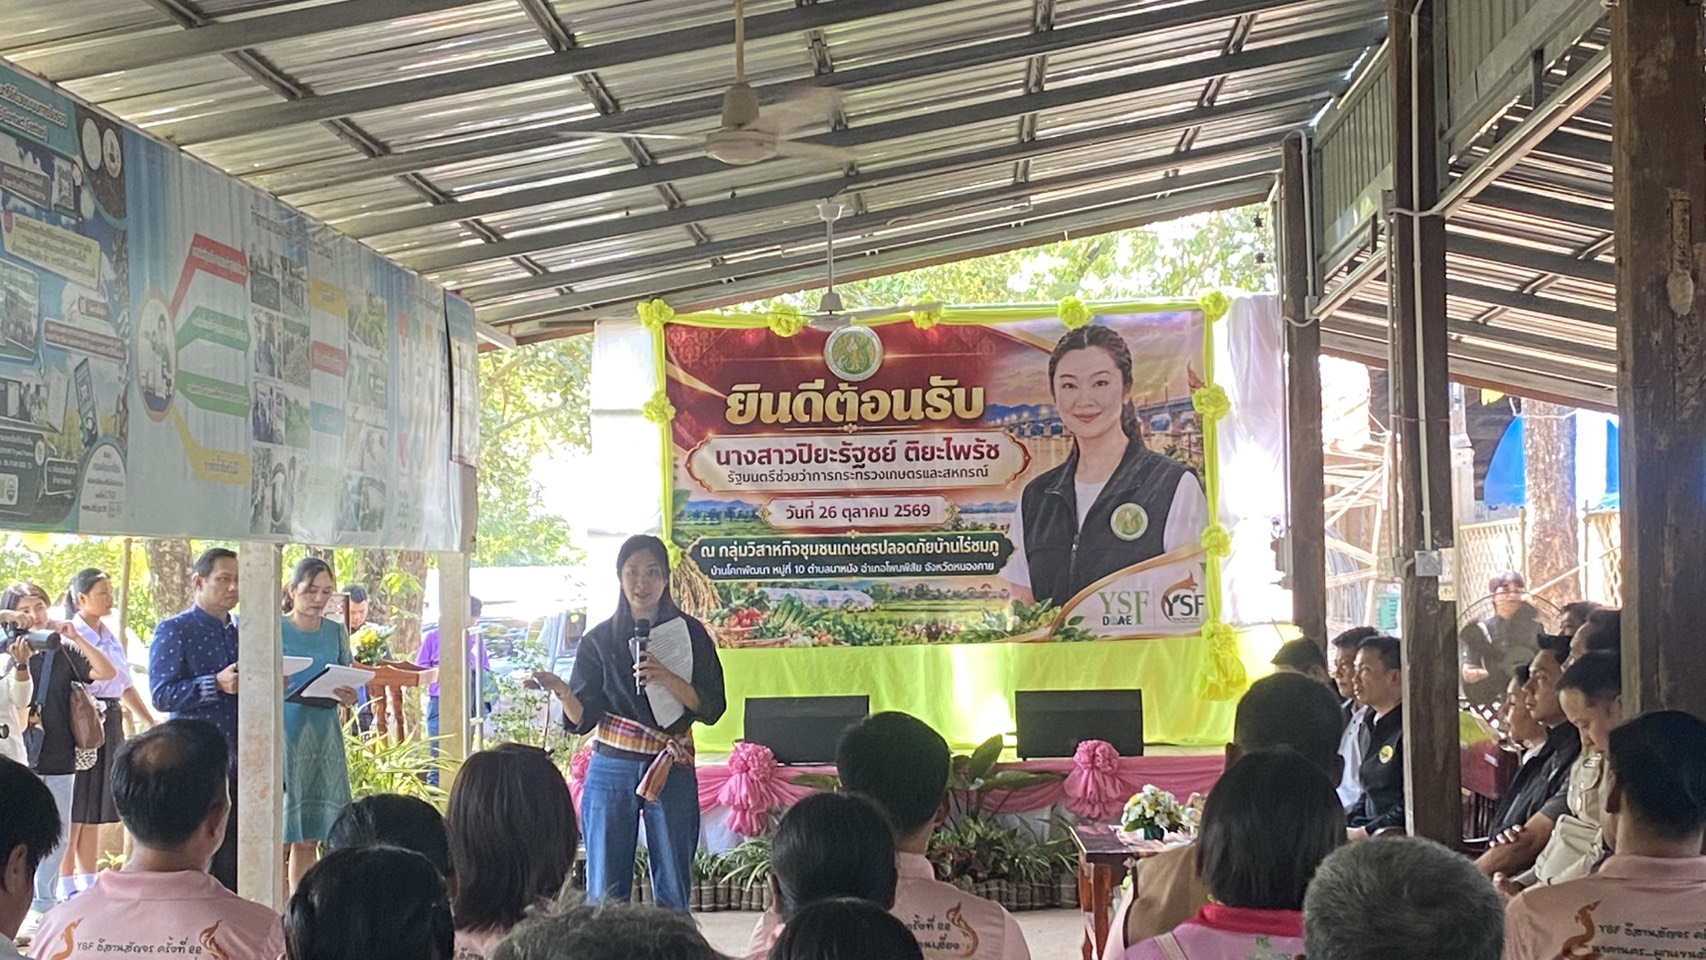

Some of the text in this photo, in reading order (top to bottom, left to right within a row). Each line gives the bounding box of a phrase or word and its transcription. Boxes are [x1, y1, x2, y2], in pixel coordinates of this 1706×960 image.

[725, 376, 985, 425] ยินดีต้อนรับ
[716, 437, 1000, 469] นางสาวปิยะรัฐชย์ ติยะไพรัช
[728, 465, 989, 486] รัฐมนตรีช่วยว่าการกระทรวงเกษตรและสหกรณ์
[786, 501, 931, 522] วันที่ 26 ตุลาคม 2569
[701, 536, 999, 562] ณ กลุ่มวิสาหกิจชุมชนเกษตรปลอดภัยบ้านไร่ชมภู
[711, 563, 770, 577] บ้านโคกพัฒนา
[773, 561, 792, 577] หมู่ที่
[794, 565, 805, 574] 10
[925, 560, 995, 572] จังหวัดหนองคาย
[1098, 591, 1149, 625] YSF
[1163, 594, 1205, 617] YSF
[77, 941, 94, 951] YSF
